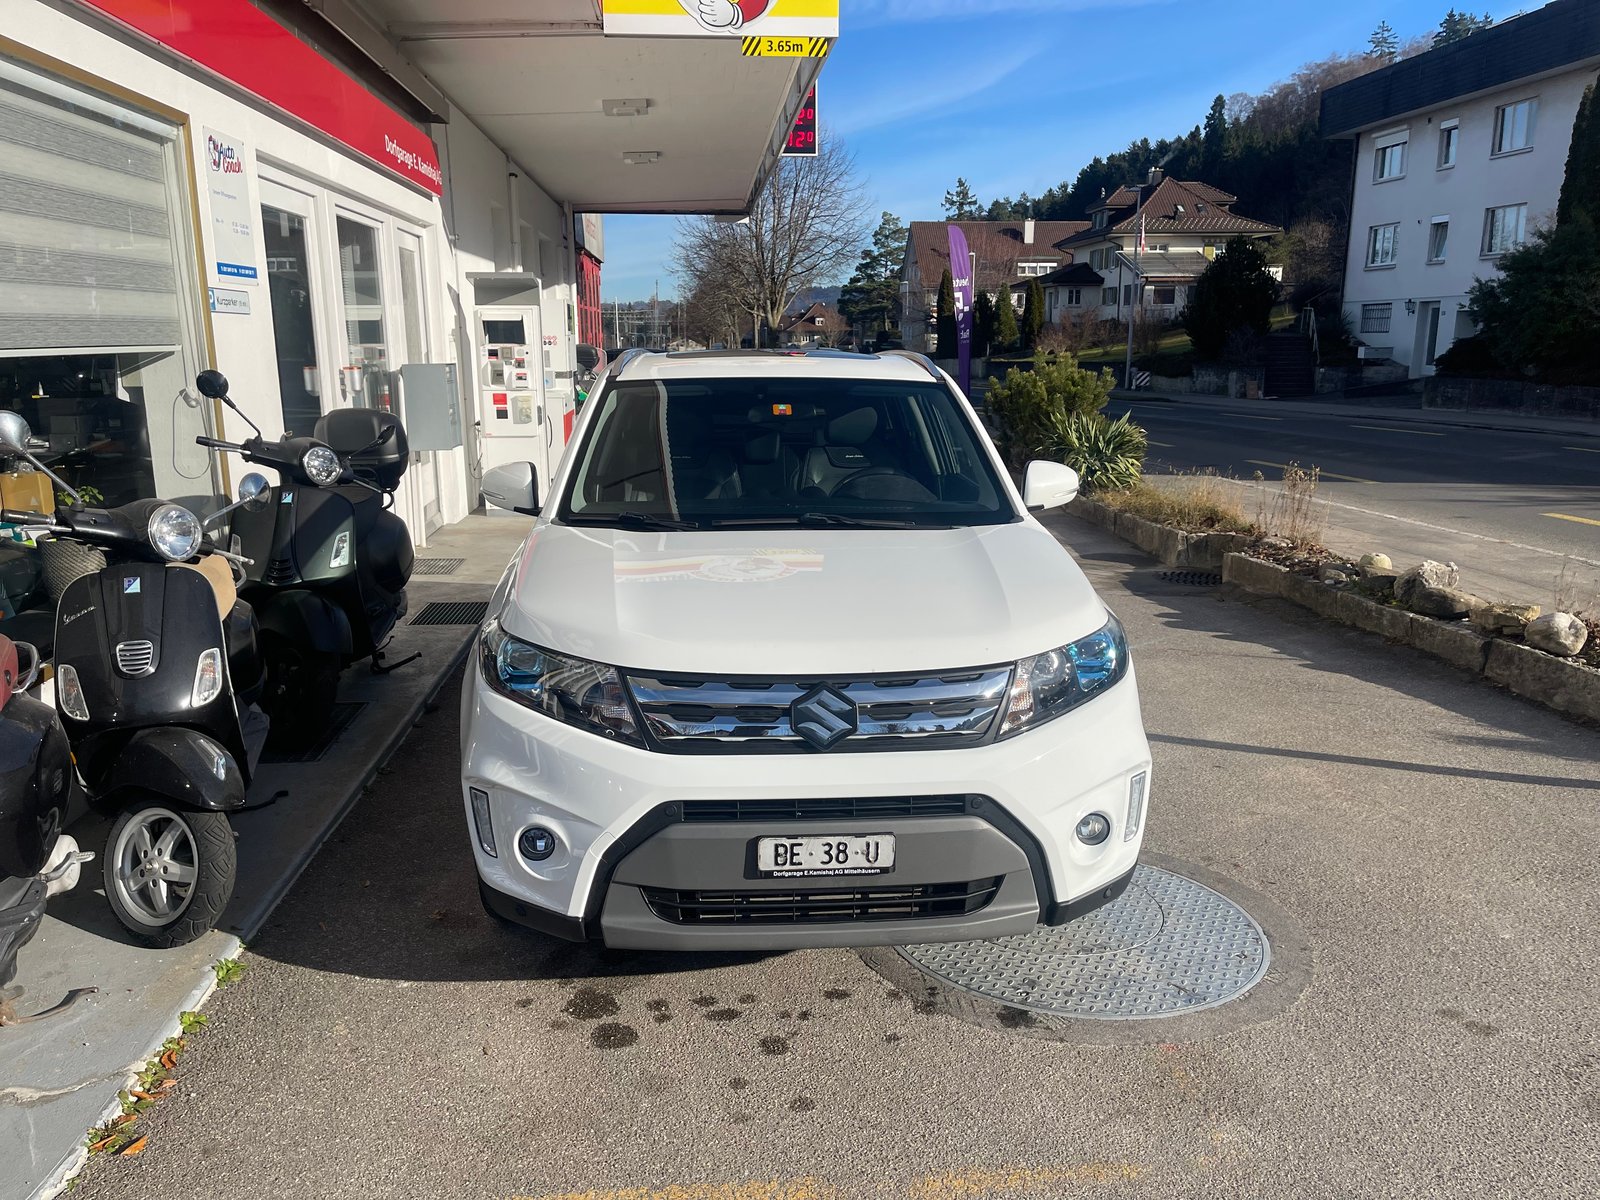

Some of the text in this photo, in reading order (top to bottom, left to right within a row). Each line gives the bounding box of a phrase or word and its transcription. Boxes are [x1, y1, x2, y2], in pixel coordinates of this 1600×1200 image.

[766, 40, 803, 53] 3.65m
[219, 142, 235, 160] Auto
[384, 134, 414, 169] Dorfgarage
[773, 840, 880, 867] BE 38 U
[773, 870, 804, 878] Dorfgarage
